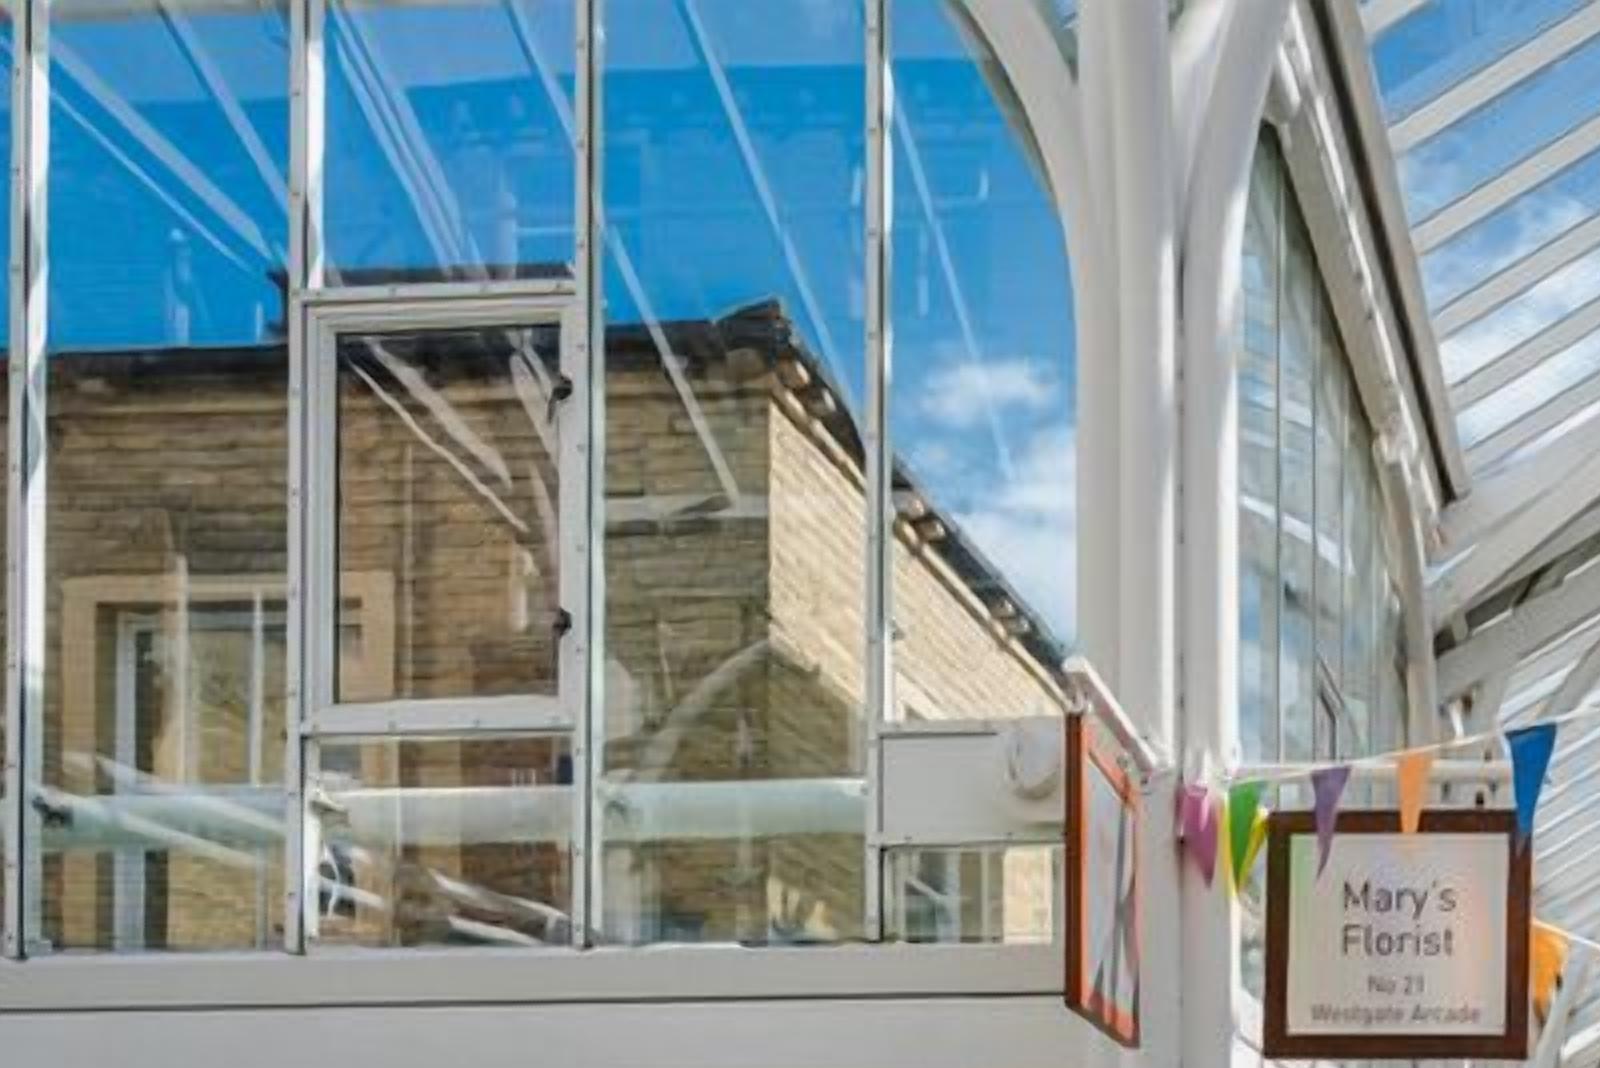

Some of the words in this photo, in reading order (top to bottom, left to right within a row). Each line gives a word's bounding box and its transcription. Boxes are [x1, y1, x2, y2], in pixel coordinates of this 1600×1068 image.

[1343, 879, 1457, 920] Mary's
[1342, 923, 1454, 957] Florist
[1403, 974, 1425, 995] 21
[1310, 1003, 1405, 1026] Westgate
[1411, 1003, 1482, 1024] Arcade
